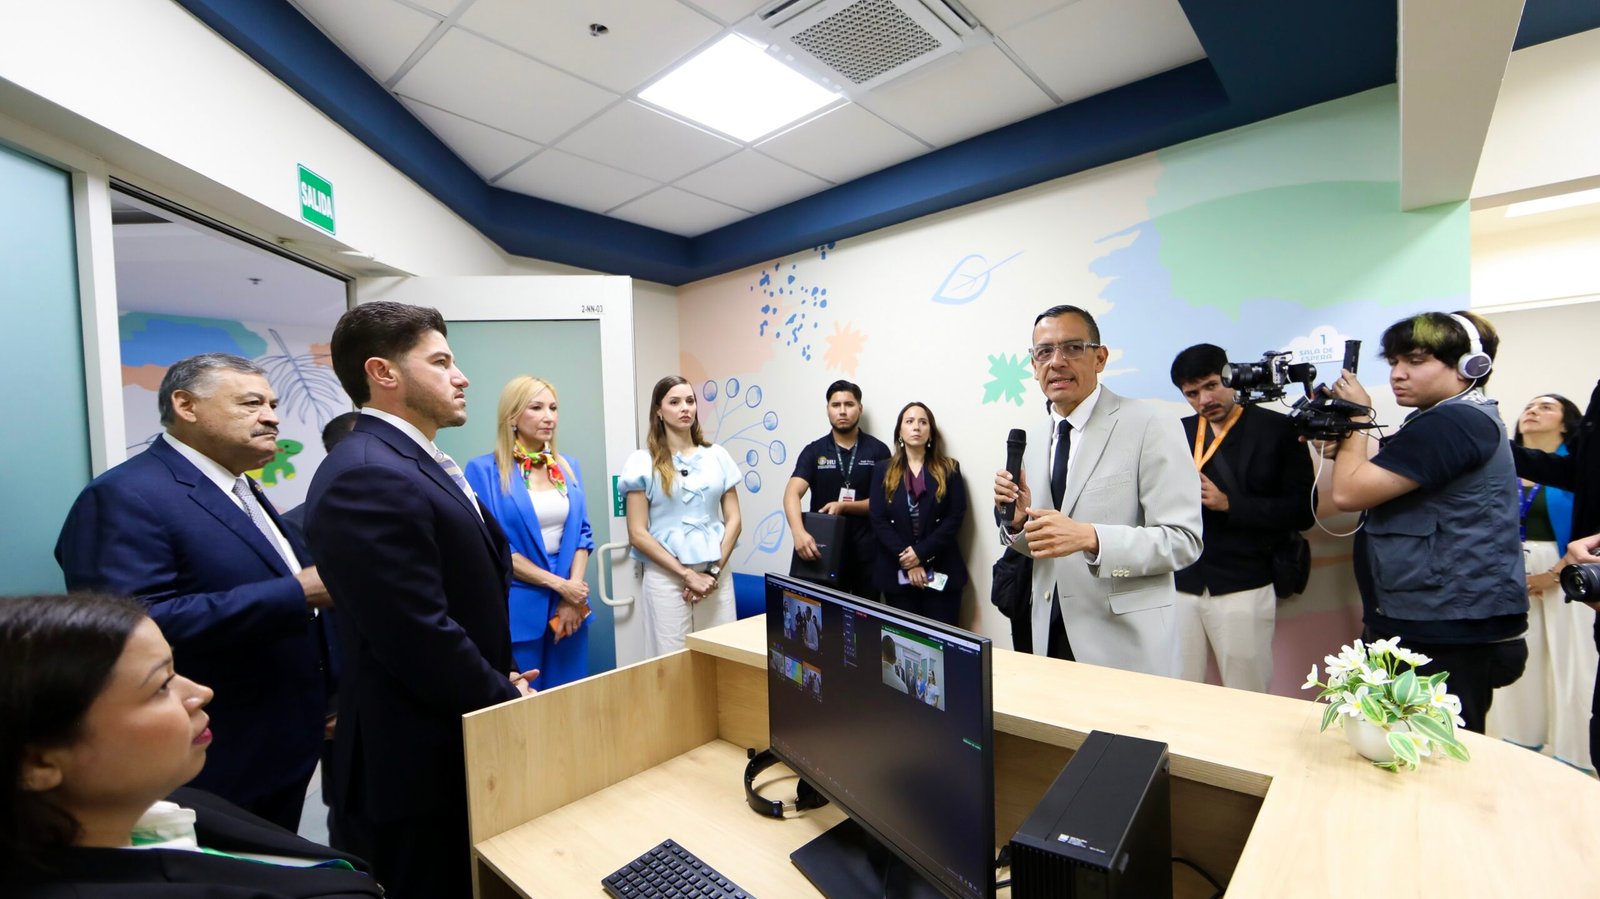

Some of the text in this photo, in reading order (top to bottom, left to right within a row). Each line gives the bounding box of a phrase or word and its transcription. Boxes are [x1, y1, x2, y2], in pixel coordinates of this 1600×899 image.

[301, 181, 334, 219] SALIDA
[581, 304, 603, 313] 2-NN-03
[1319, 334, 1326, 345] 1
[1298, 348, 1321, 357] SALA
[1300, 354, 1333, 362] ESPERA
